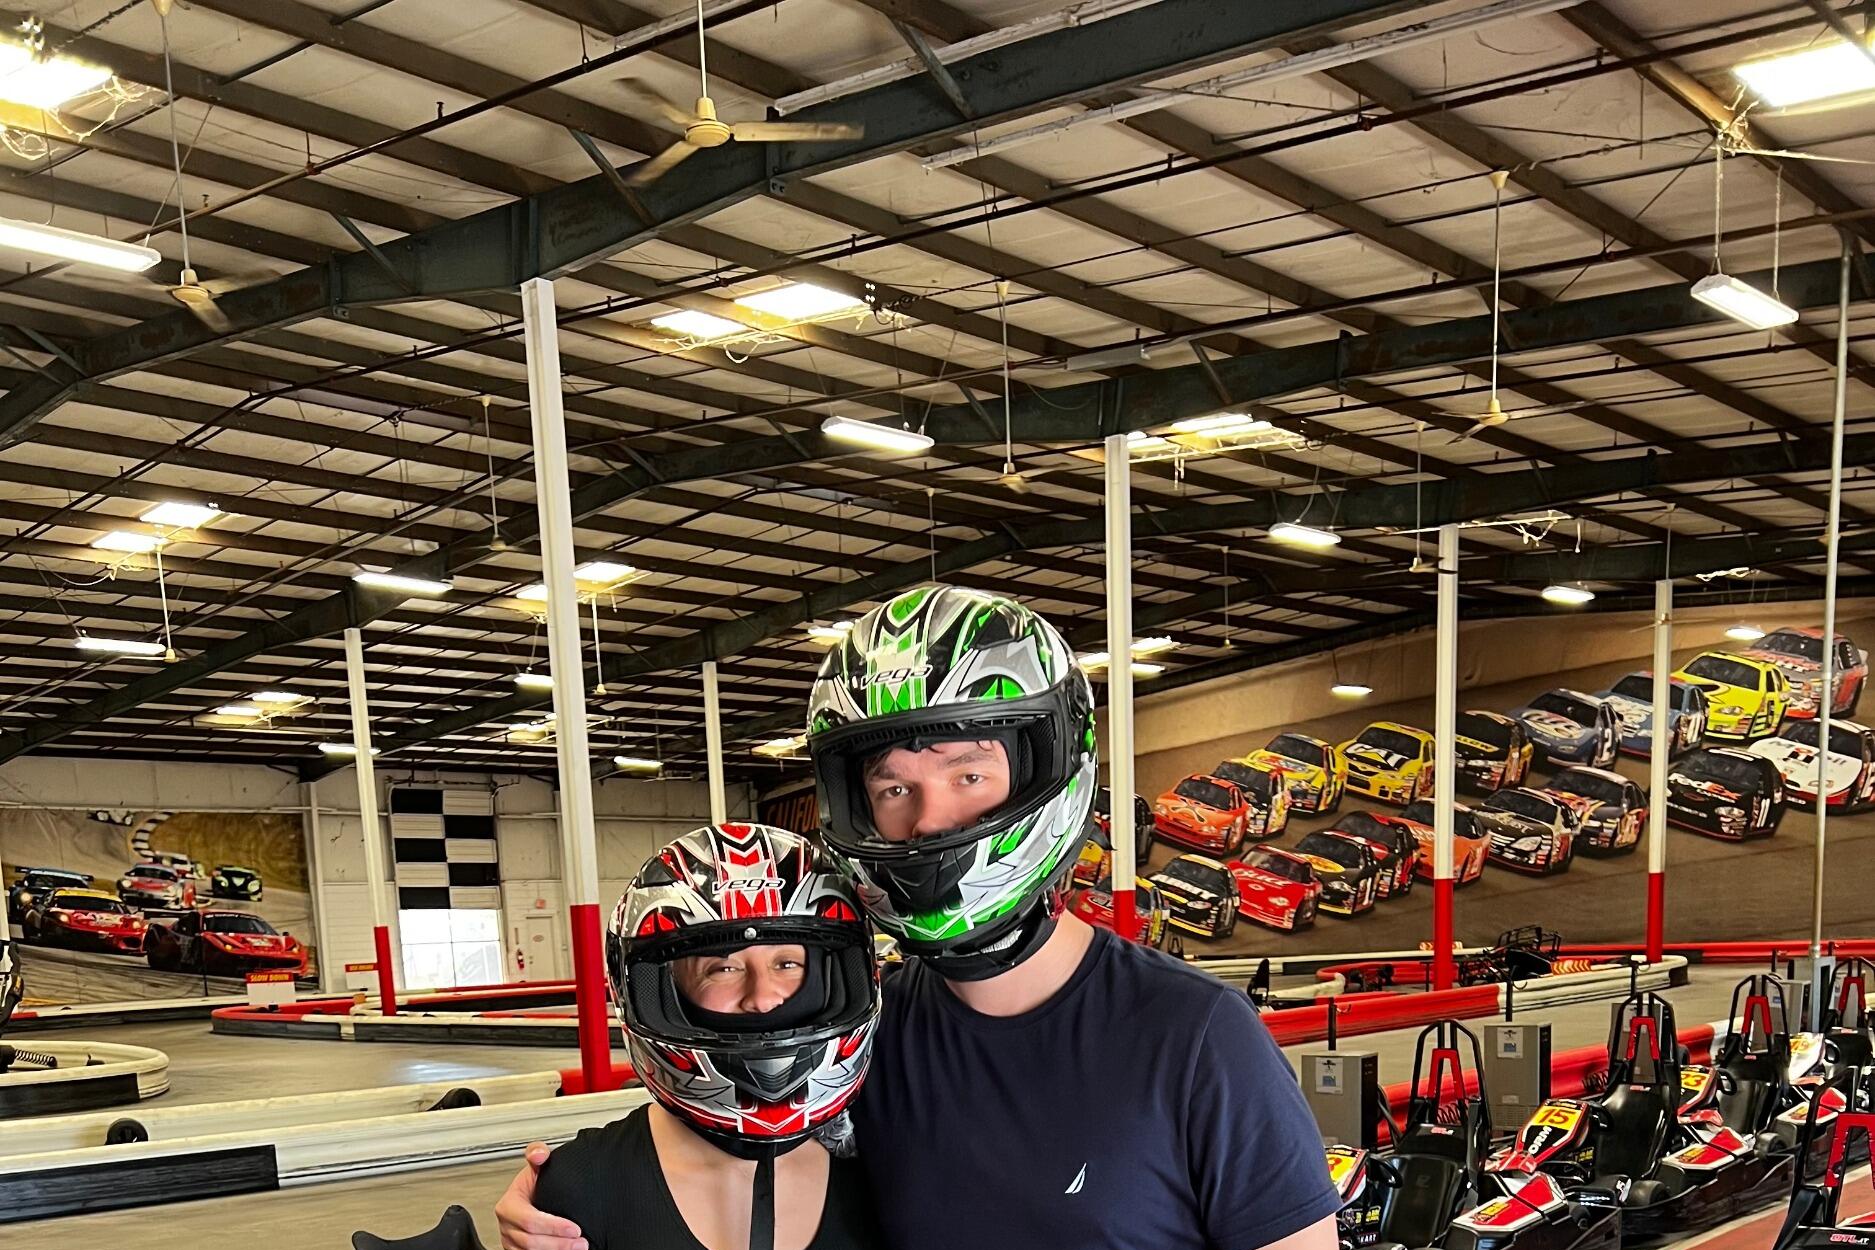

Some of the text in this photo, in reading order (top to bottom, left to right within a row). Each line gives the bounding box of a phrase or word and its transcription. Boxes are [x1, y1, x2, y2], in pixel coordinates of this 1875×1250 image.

[861, 664, 934, 690] vega
[1346, 743, 1410, 768] CAT
[712, 878, 786, 895] vega
[250, 974, 268, 982] SLOW
[1538, 1108, 1577, 1125] 15
[1528, 1125, 1553, 1155] ORM
